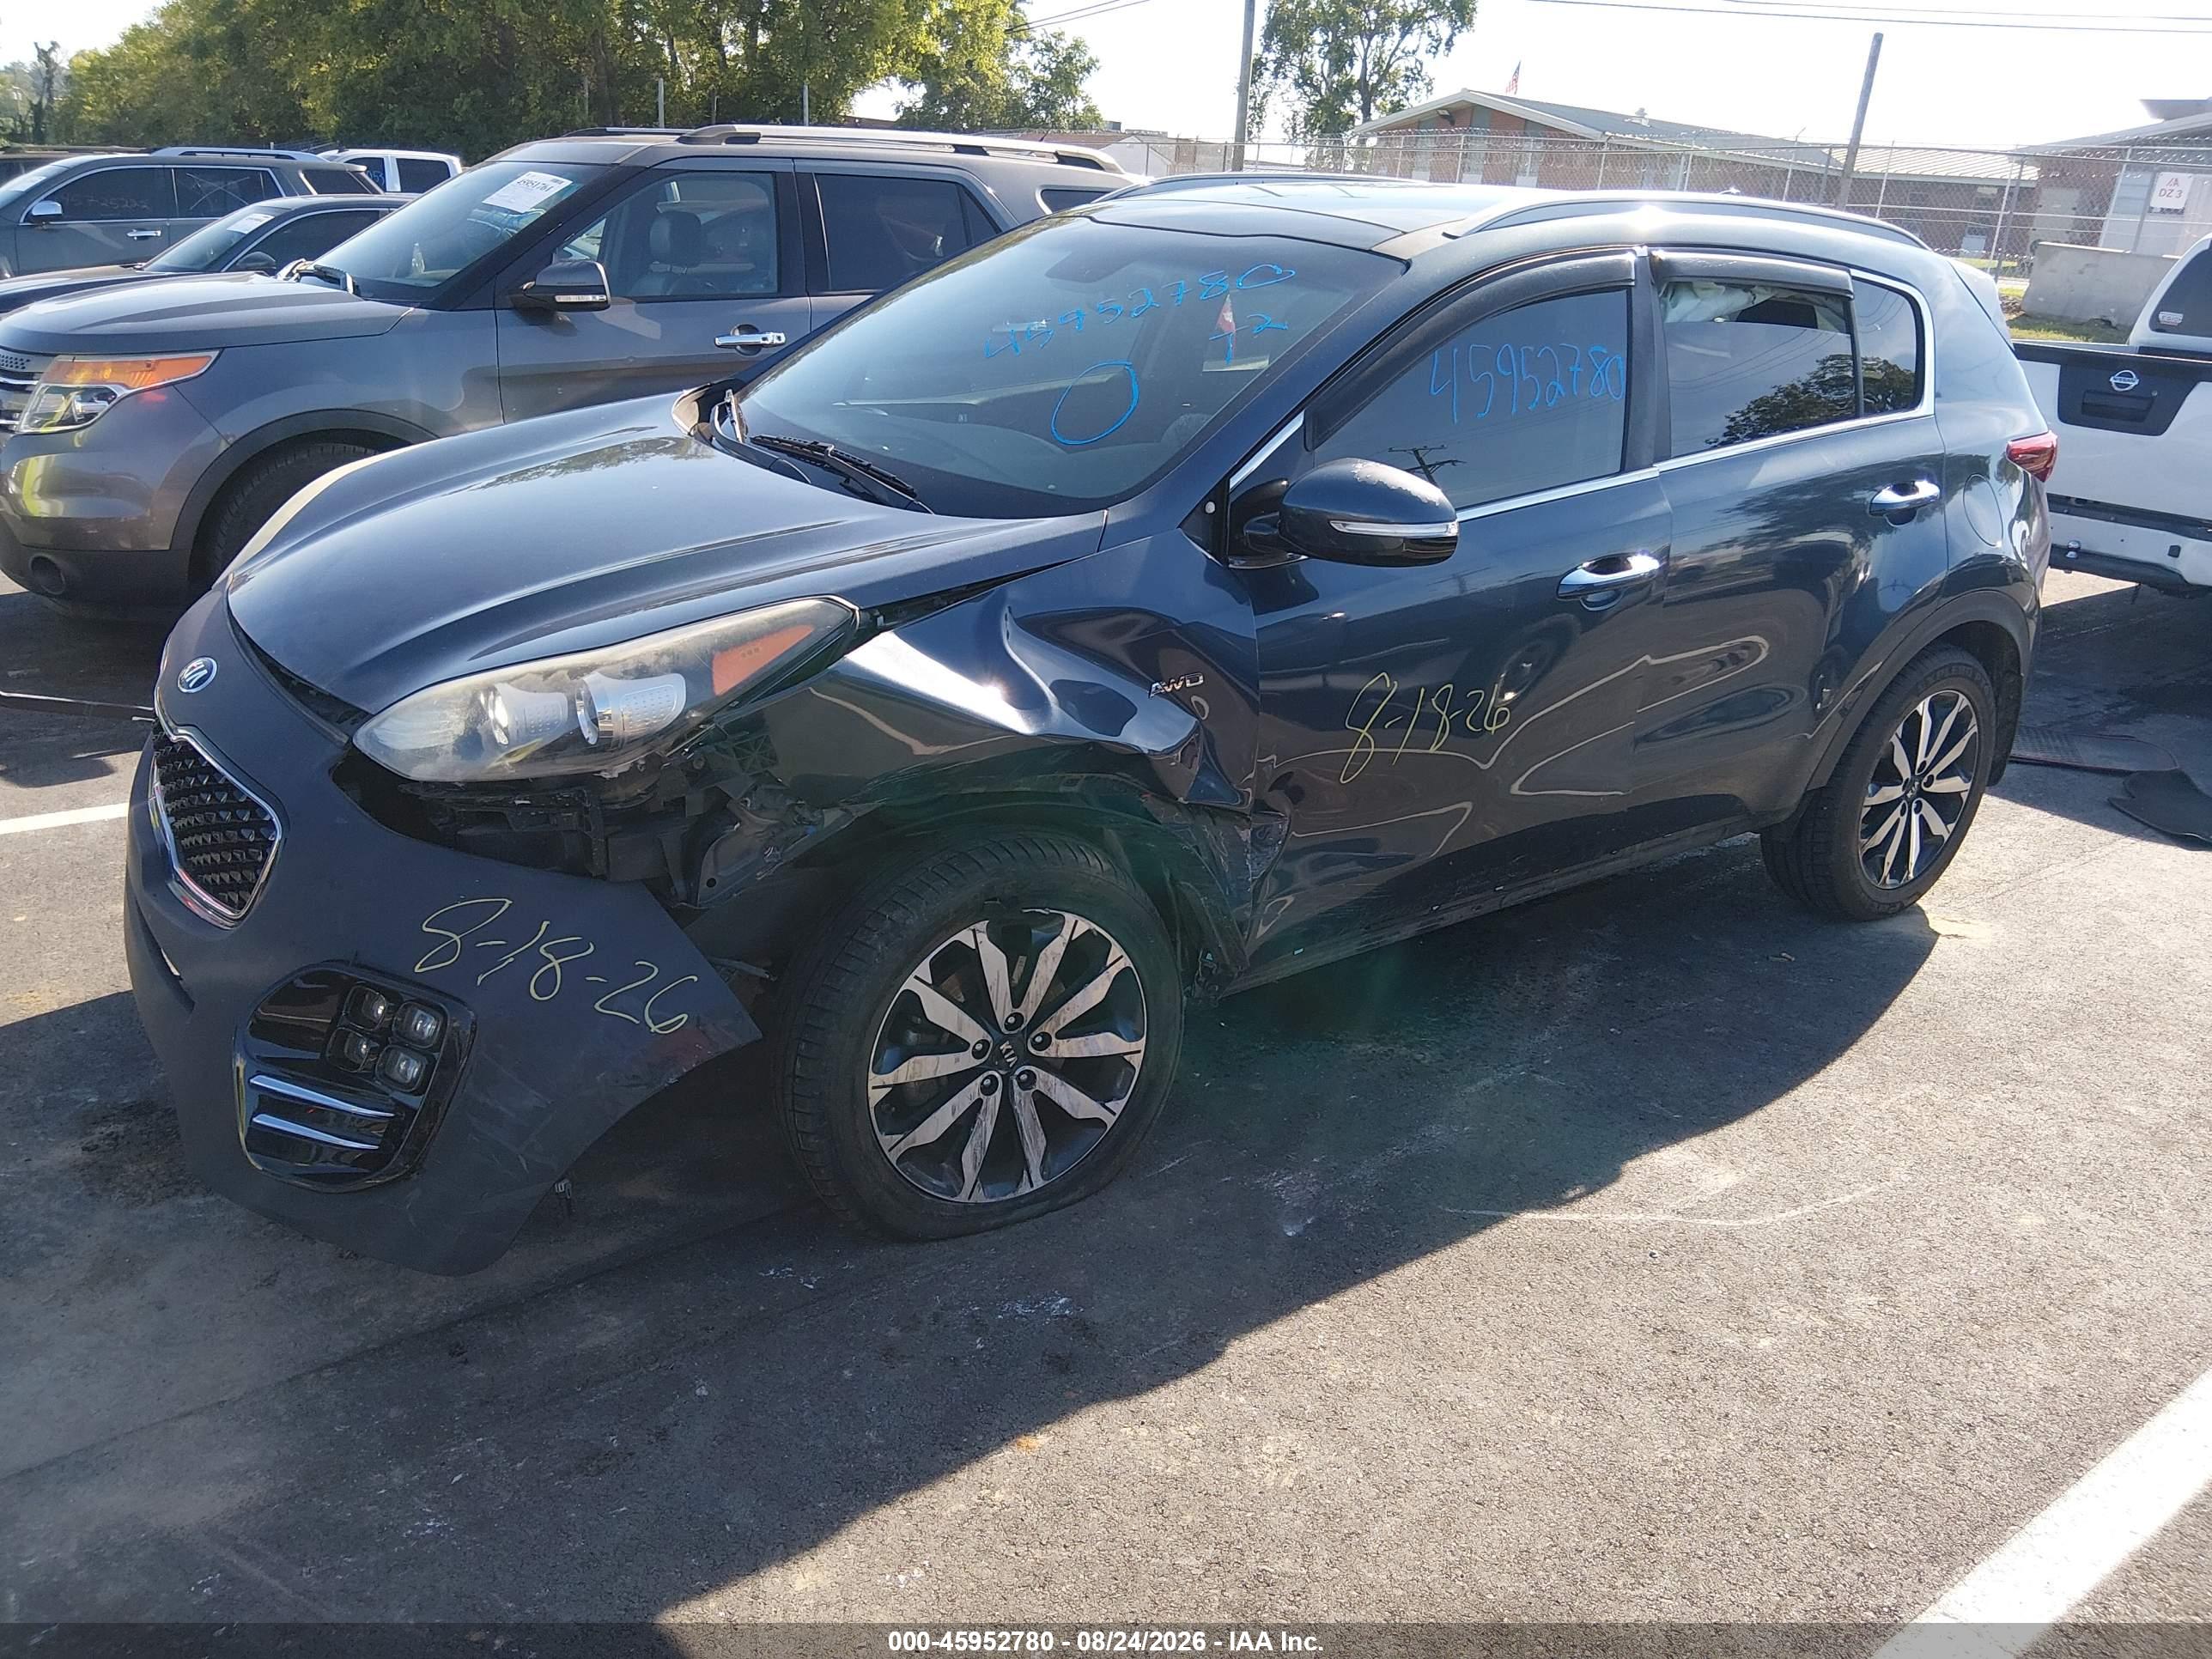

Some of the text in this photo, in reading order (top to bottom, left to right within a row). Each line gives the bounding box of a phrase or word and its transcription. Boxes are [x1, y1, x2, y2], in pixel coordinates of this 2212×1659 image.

[2158, 188, 2184, 198] DZ 3
[983, 264, 1296, 358] 45952780
[1428, 343, 1626, 424] 45952780
[1150, 672, 1204, 697] AWD
[1340, 672, 1510, 783] 8-18-26
[1000, 1040, 1018, 1067] KIA
